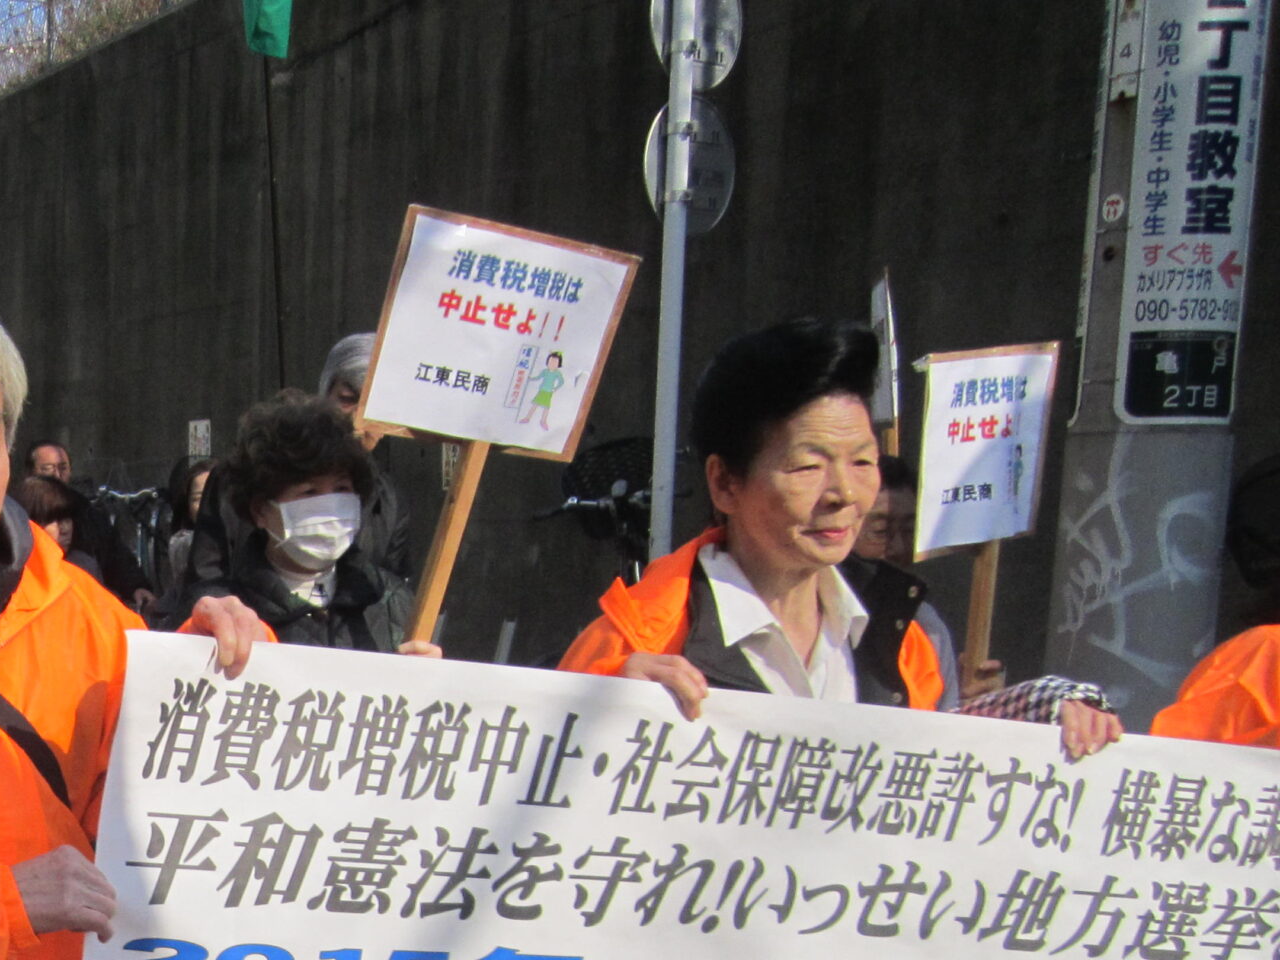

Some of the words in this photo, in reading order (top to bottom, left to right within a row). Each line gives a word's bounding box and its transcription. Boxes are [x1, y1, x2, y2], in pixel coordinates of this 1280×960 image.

[1119, 42, 1133, 59] 4
[1141, 19, 1182, 237] 幼児・小学生・中学生
[1142, 242, 1215, 267] すぐ先
[447, 248, 584, 304] 消費税増税は
[1136, 267, 1214, 293] カメリアプラザ内
[413, 362, 492, 396] 江東民商
[1162, 384, 1219, 408] 2丁目
[941, 482, 993, 506] 江東民商
